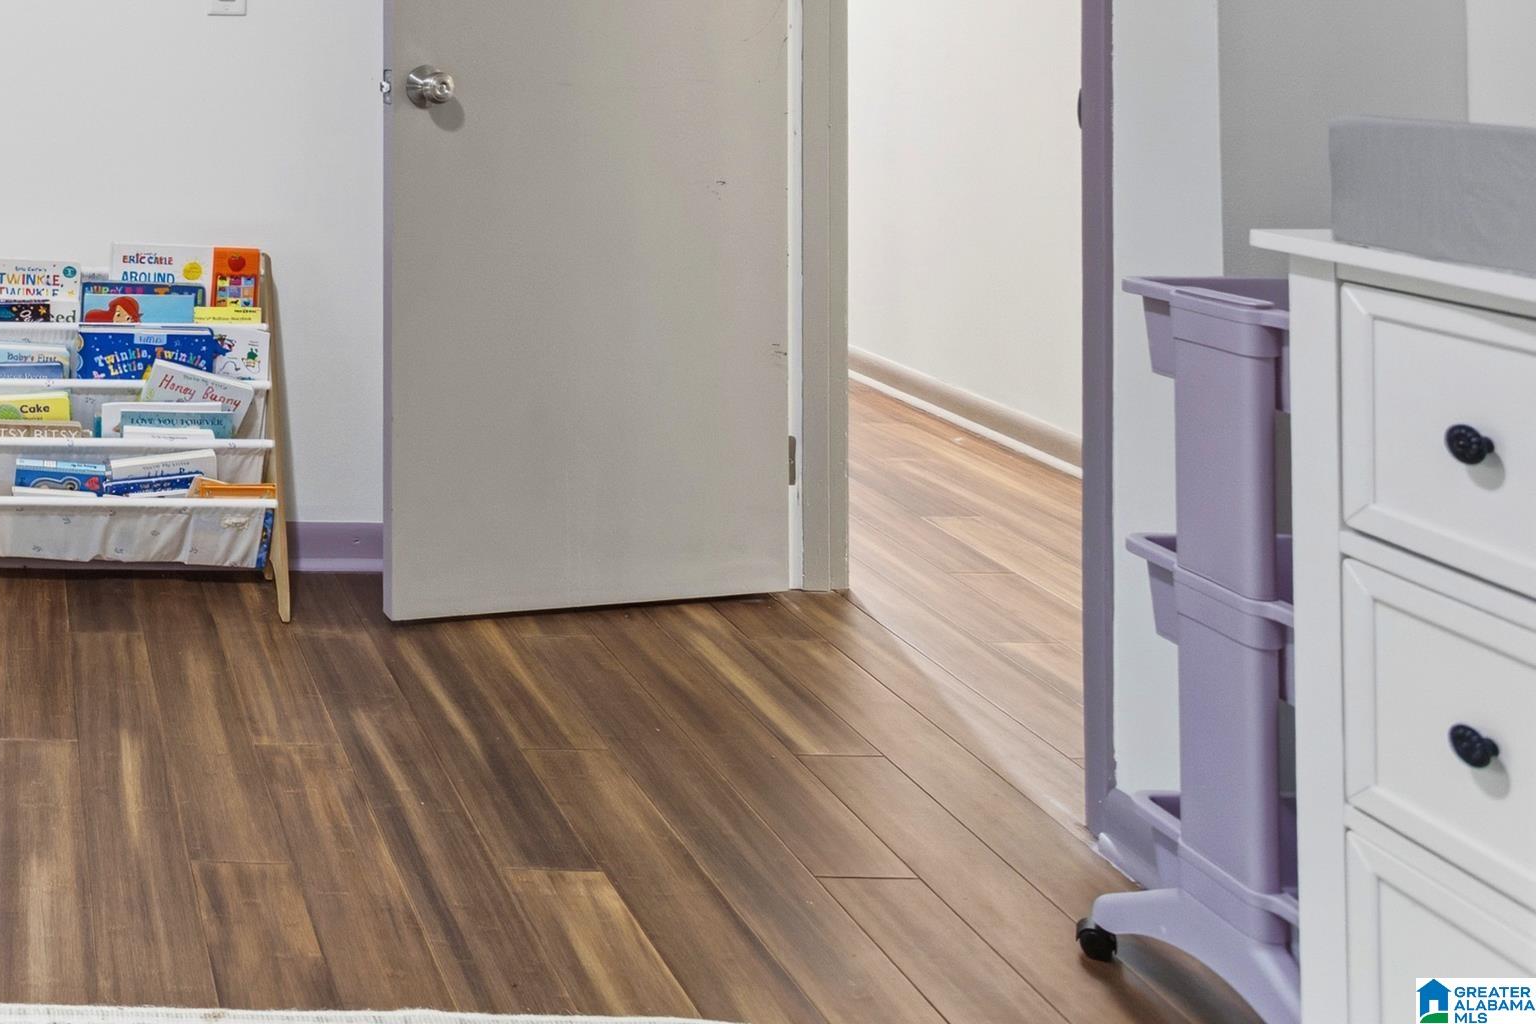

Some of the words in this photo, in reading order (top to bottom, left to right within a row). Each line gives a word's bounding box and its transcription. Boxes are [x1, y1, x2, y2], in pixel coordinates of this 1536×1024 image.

[122, 255, 145, 264] ERIC
[121, 271, 175, 284] AROUND
[95, 349, 151, 367] Twinkle,
[108, 362, 144, 376] Little
[158, 374, 197, 401] Honey
[202, 386, 242, 411] Bunny
[20, 404, 50, 414] Cake
[130, 416, 153, 425] LOVE
[157, 417, 178, 425] YOU
[181, 417, 224, 426] FOREVER
[34, 429, 78, 438] BITSY
